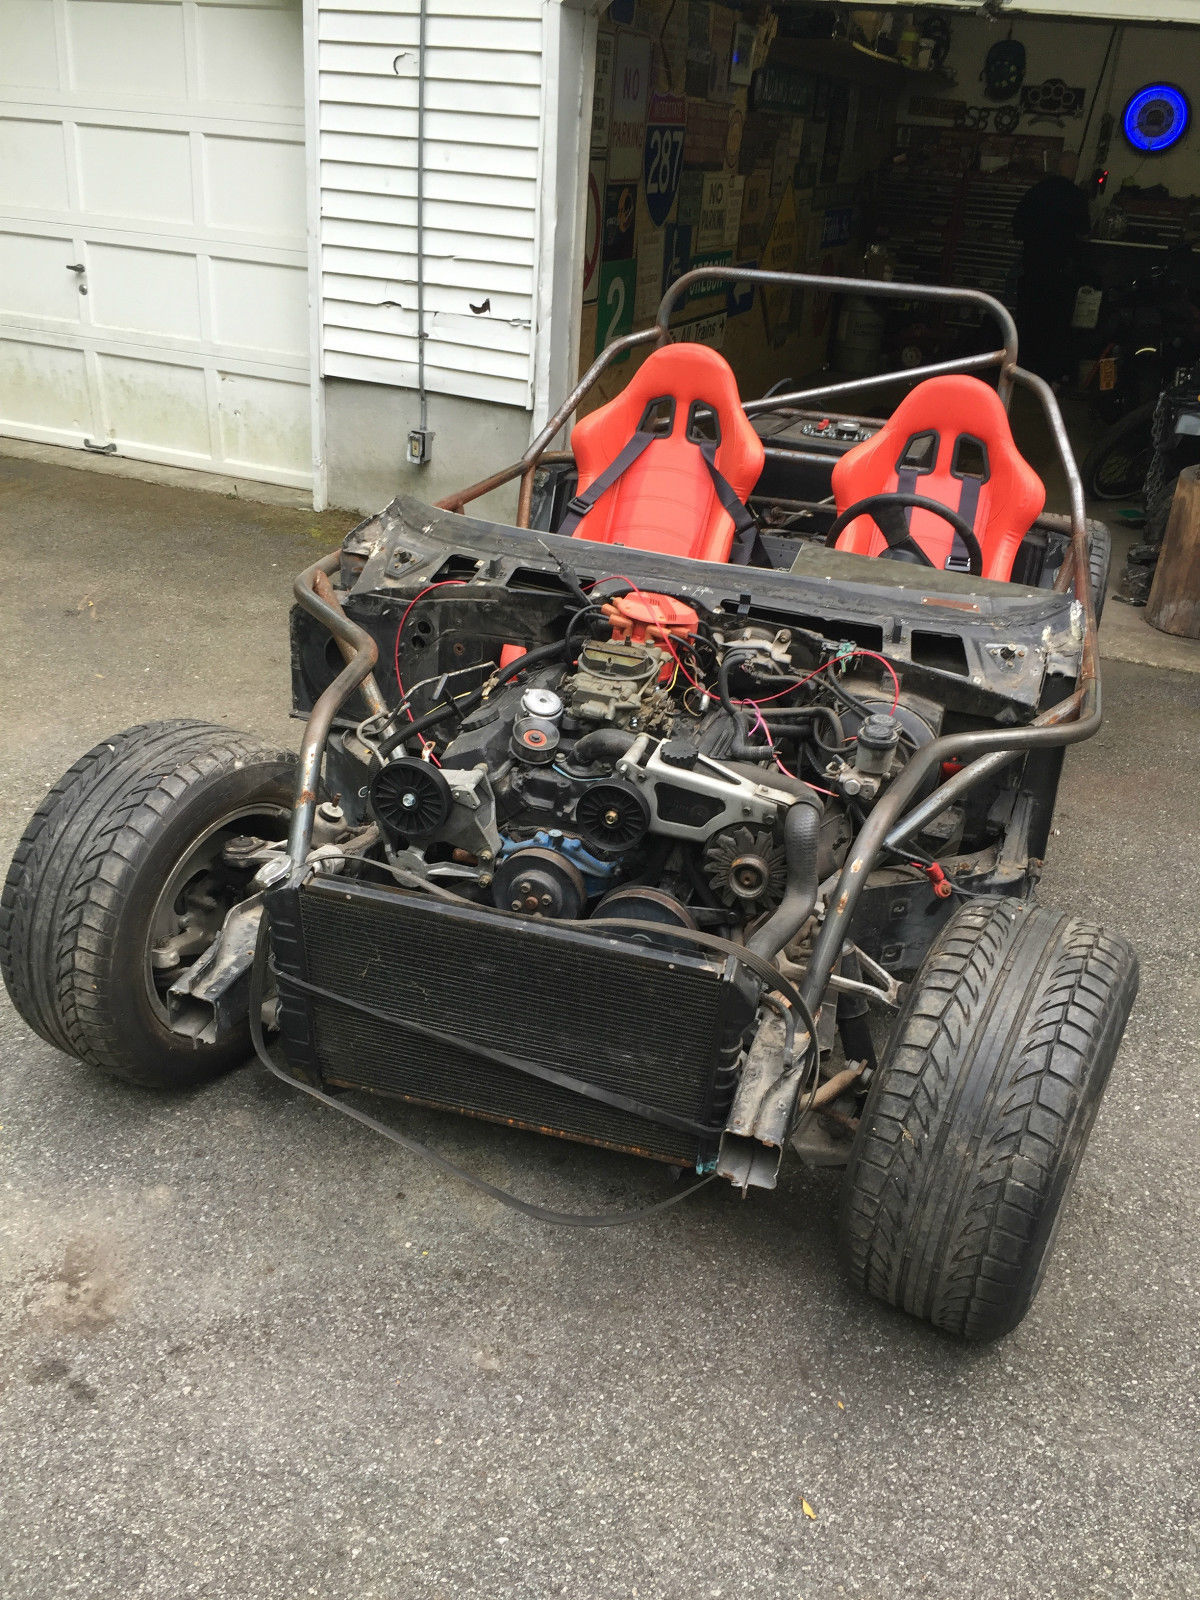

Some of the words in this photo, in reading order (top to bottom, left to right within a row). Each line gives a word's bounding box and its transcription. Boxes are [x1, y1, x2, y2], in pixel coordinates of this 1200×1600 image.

[623, 66, 641, 102] NO
[612, 121, 645, 147] PARKING
[646, 130, 684, 195] 287
[708, 182, 724, 205] NO
[603, 277, 625, 346] 2
[695, 319, 717, 341] Trains
